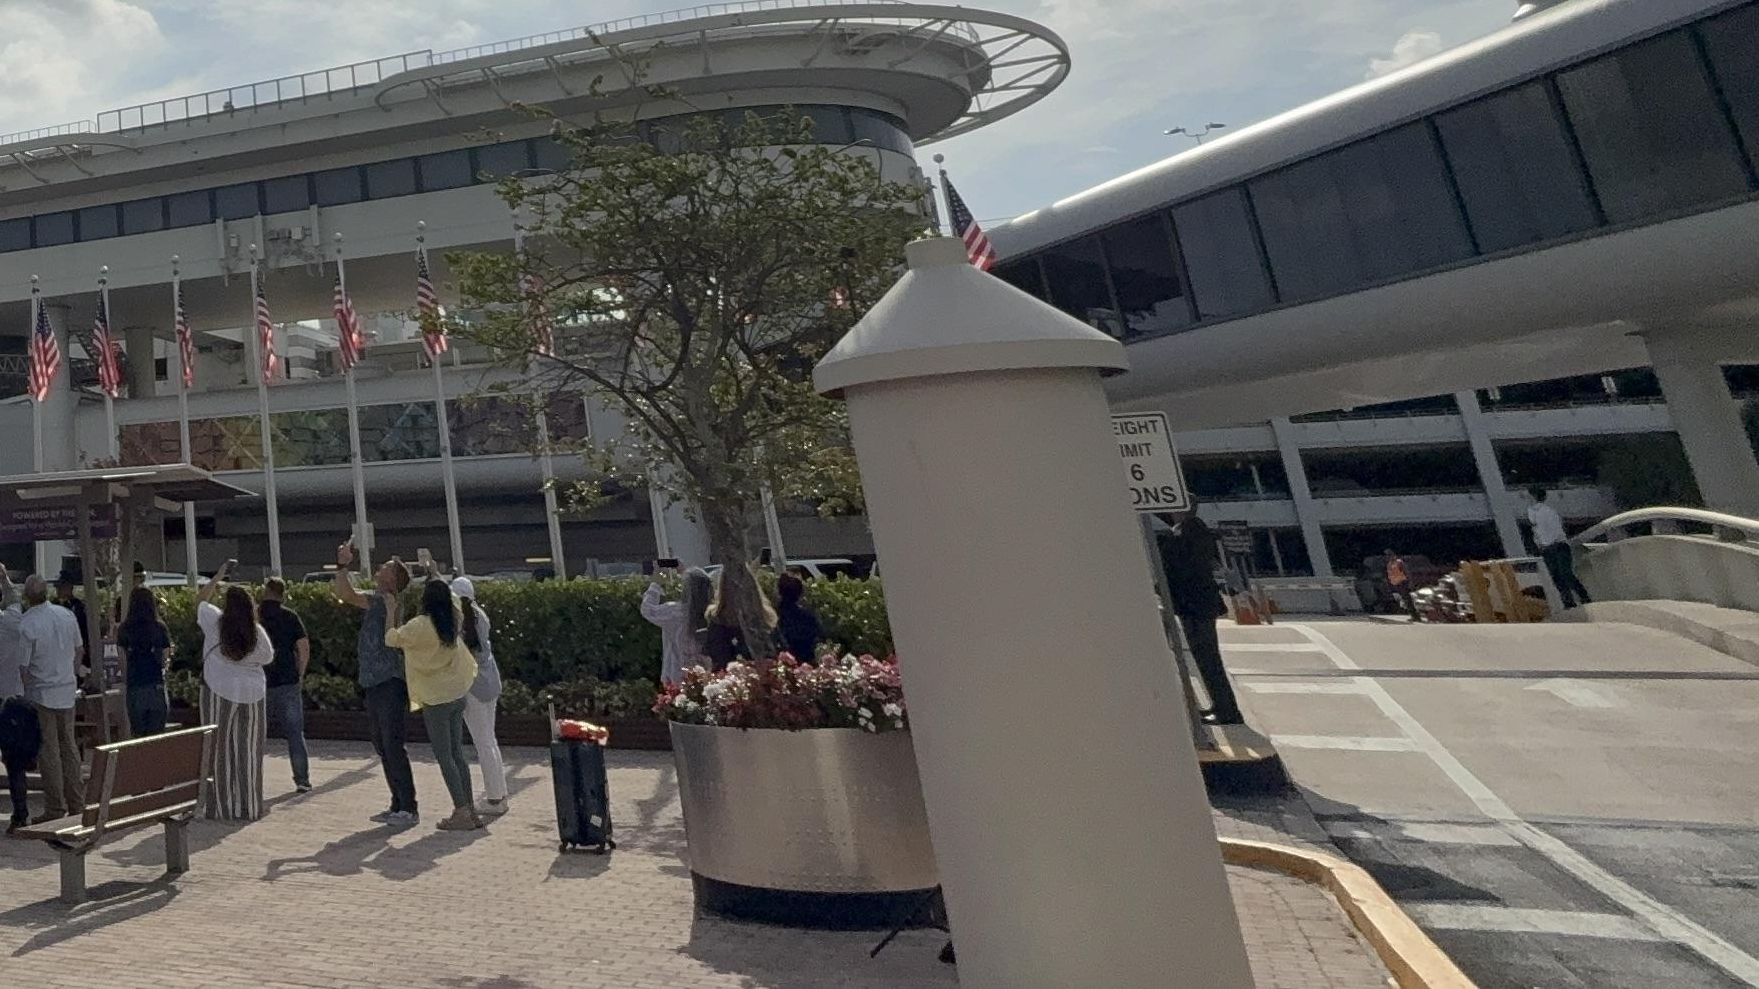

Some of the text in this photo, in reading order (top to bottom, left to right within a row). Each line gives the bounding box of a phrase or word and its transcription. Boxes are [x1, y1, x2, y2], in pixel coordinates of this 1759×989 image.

[1112, 420, 1157, 435] EIGHT
[1120, 442, 1152, 458] IMIT
[1130, 463, 1145, 481] 6
[1129, 485, 1177, 504] ONS
